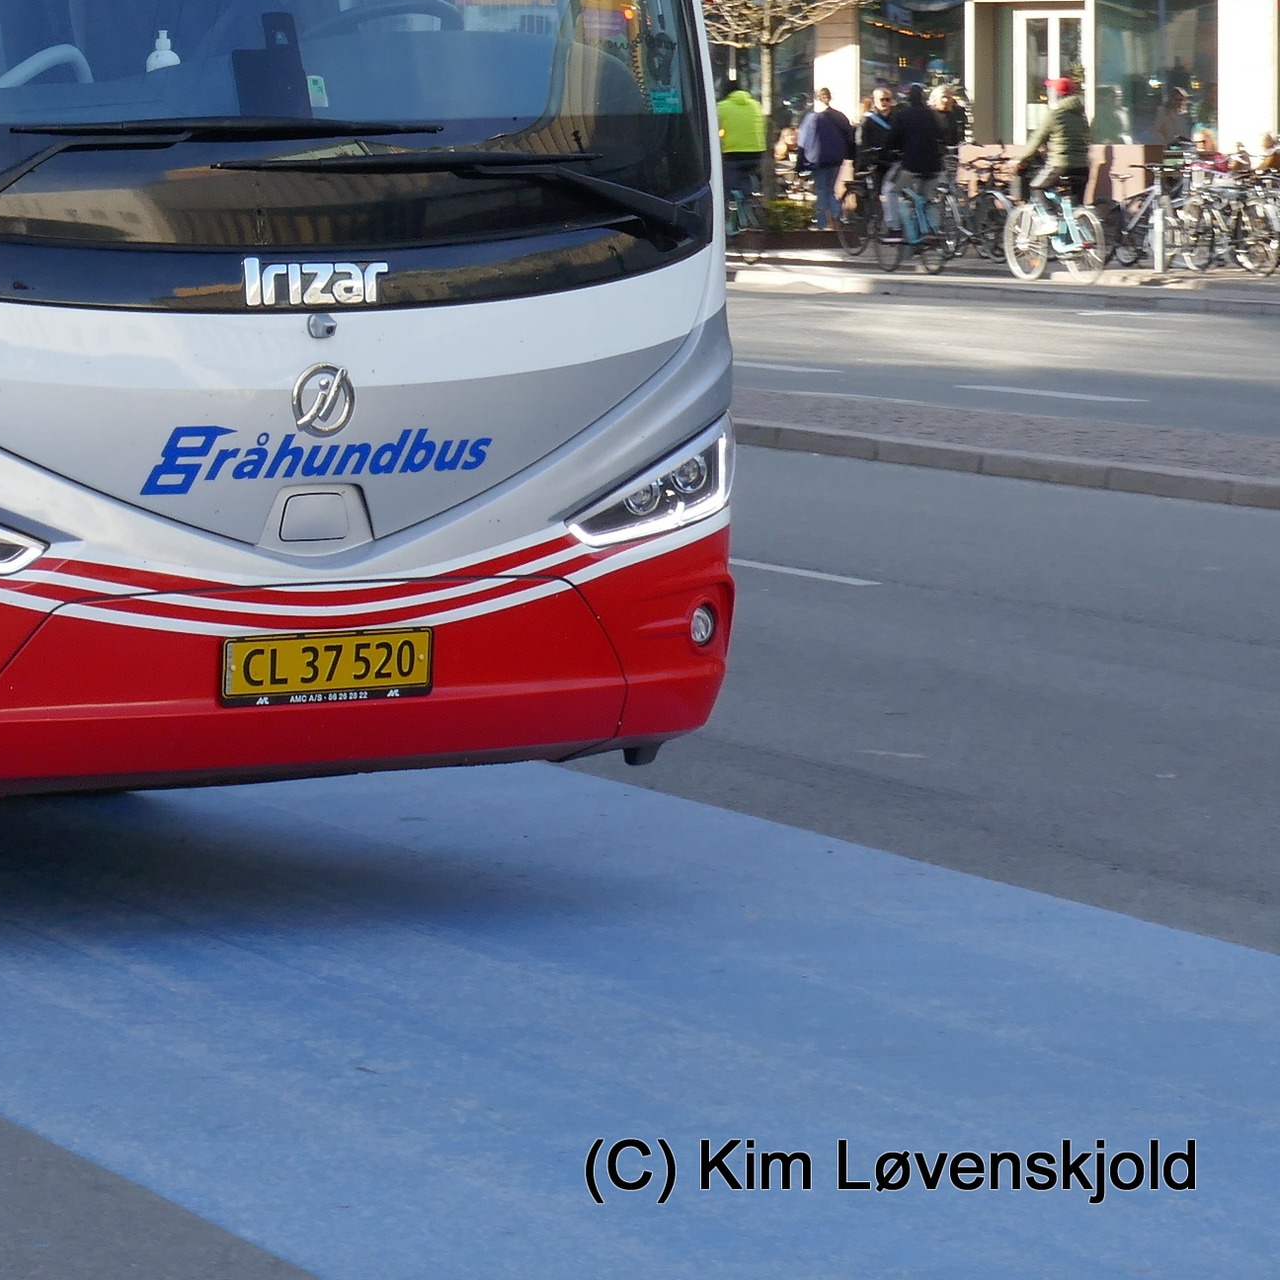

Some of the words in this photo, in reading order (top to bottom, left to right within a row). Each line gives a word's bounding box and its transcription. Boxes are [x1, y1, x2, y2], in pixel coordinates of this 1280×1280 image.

[243, 257, 389, 307] Irizar
[242, 647, 288, 687] CL
[300, 644, 343, 684] 37
[353, 639, 416, 680] 520
